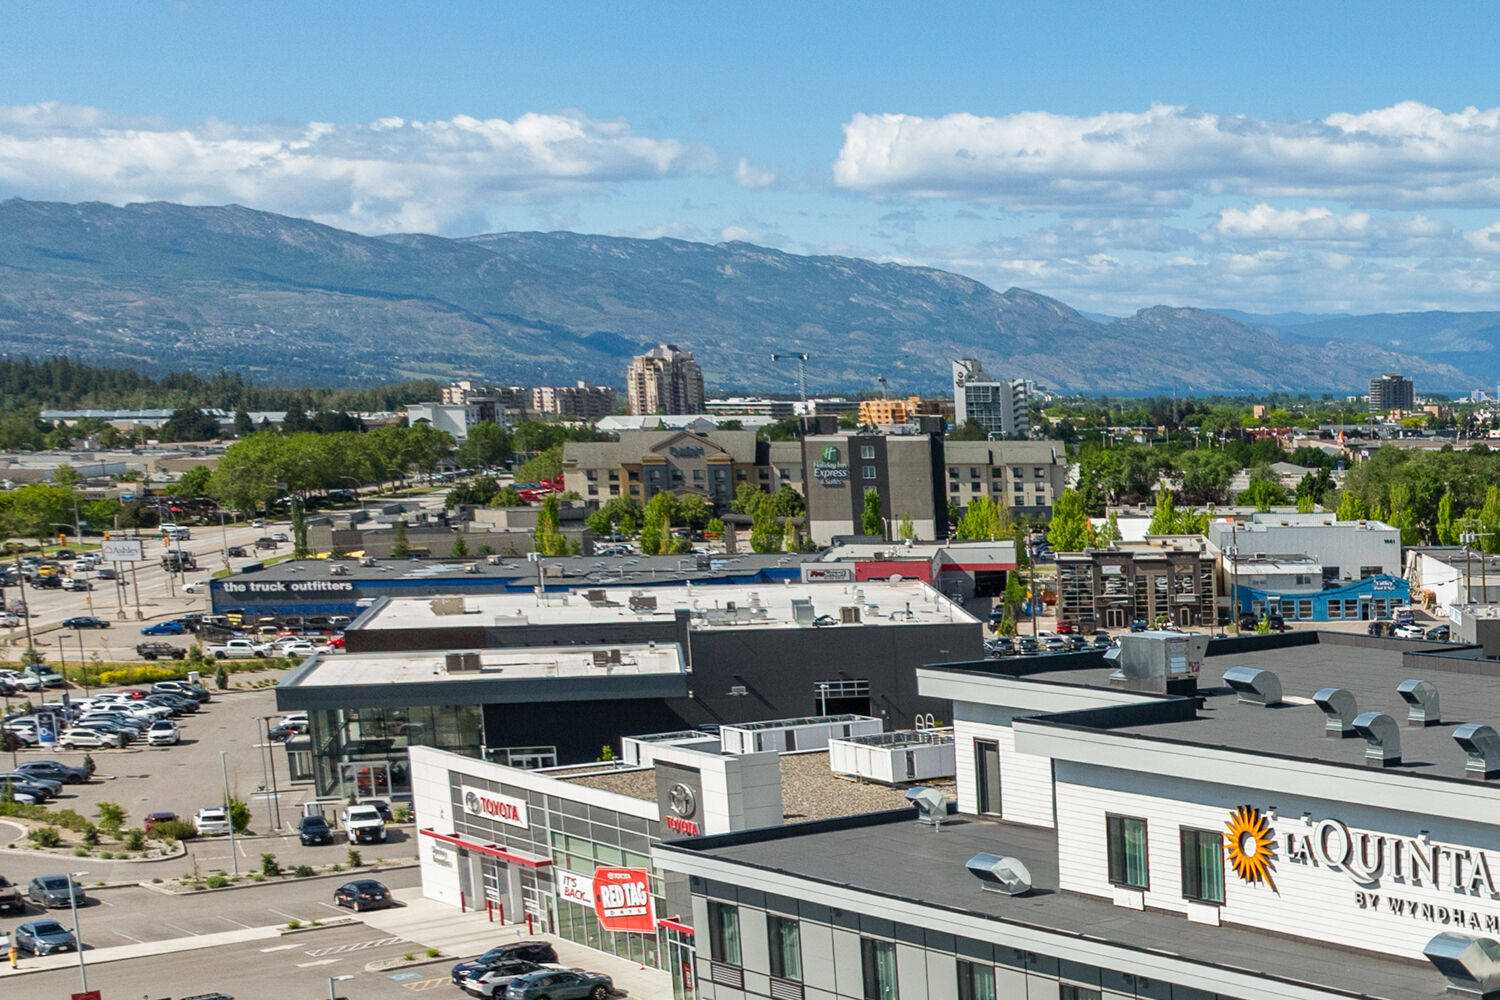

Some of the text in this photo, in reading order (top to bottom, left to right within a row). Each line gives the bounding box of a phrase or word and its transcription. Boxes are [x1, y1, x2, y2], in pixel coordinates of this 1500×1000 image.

[814, 468, 848, 479] Express
[223, 581, 353, 593] the truck outfitters
[480, 797, 521, 823] TOYOTA
[666, 815, 700, 836] TOYOTA
[1283, 818, 1500, 900] LA QUINTA
[563, 875, 578, 888] IT'S
[600, 881, 648, 909] RED TAG
[609, 908, 642, 916] DAYS
[1355, 891, 1500, 932] BY WYNDHAM
